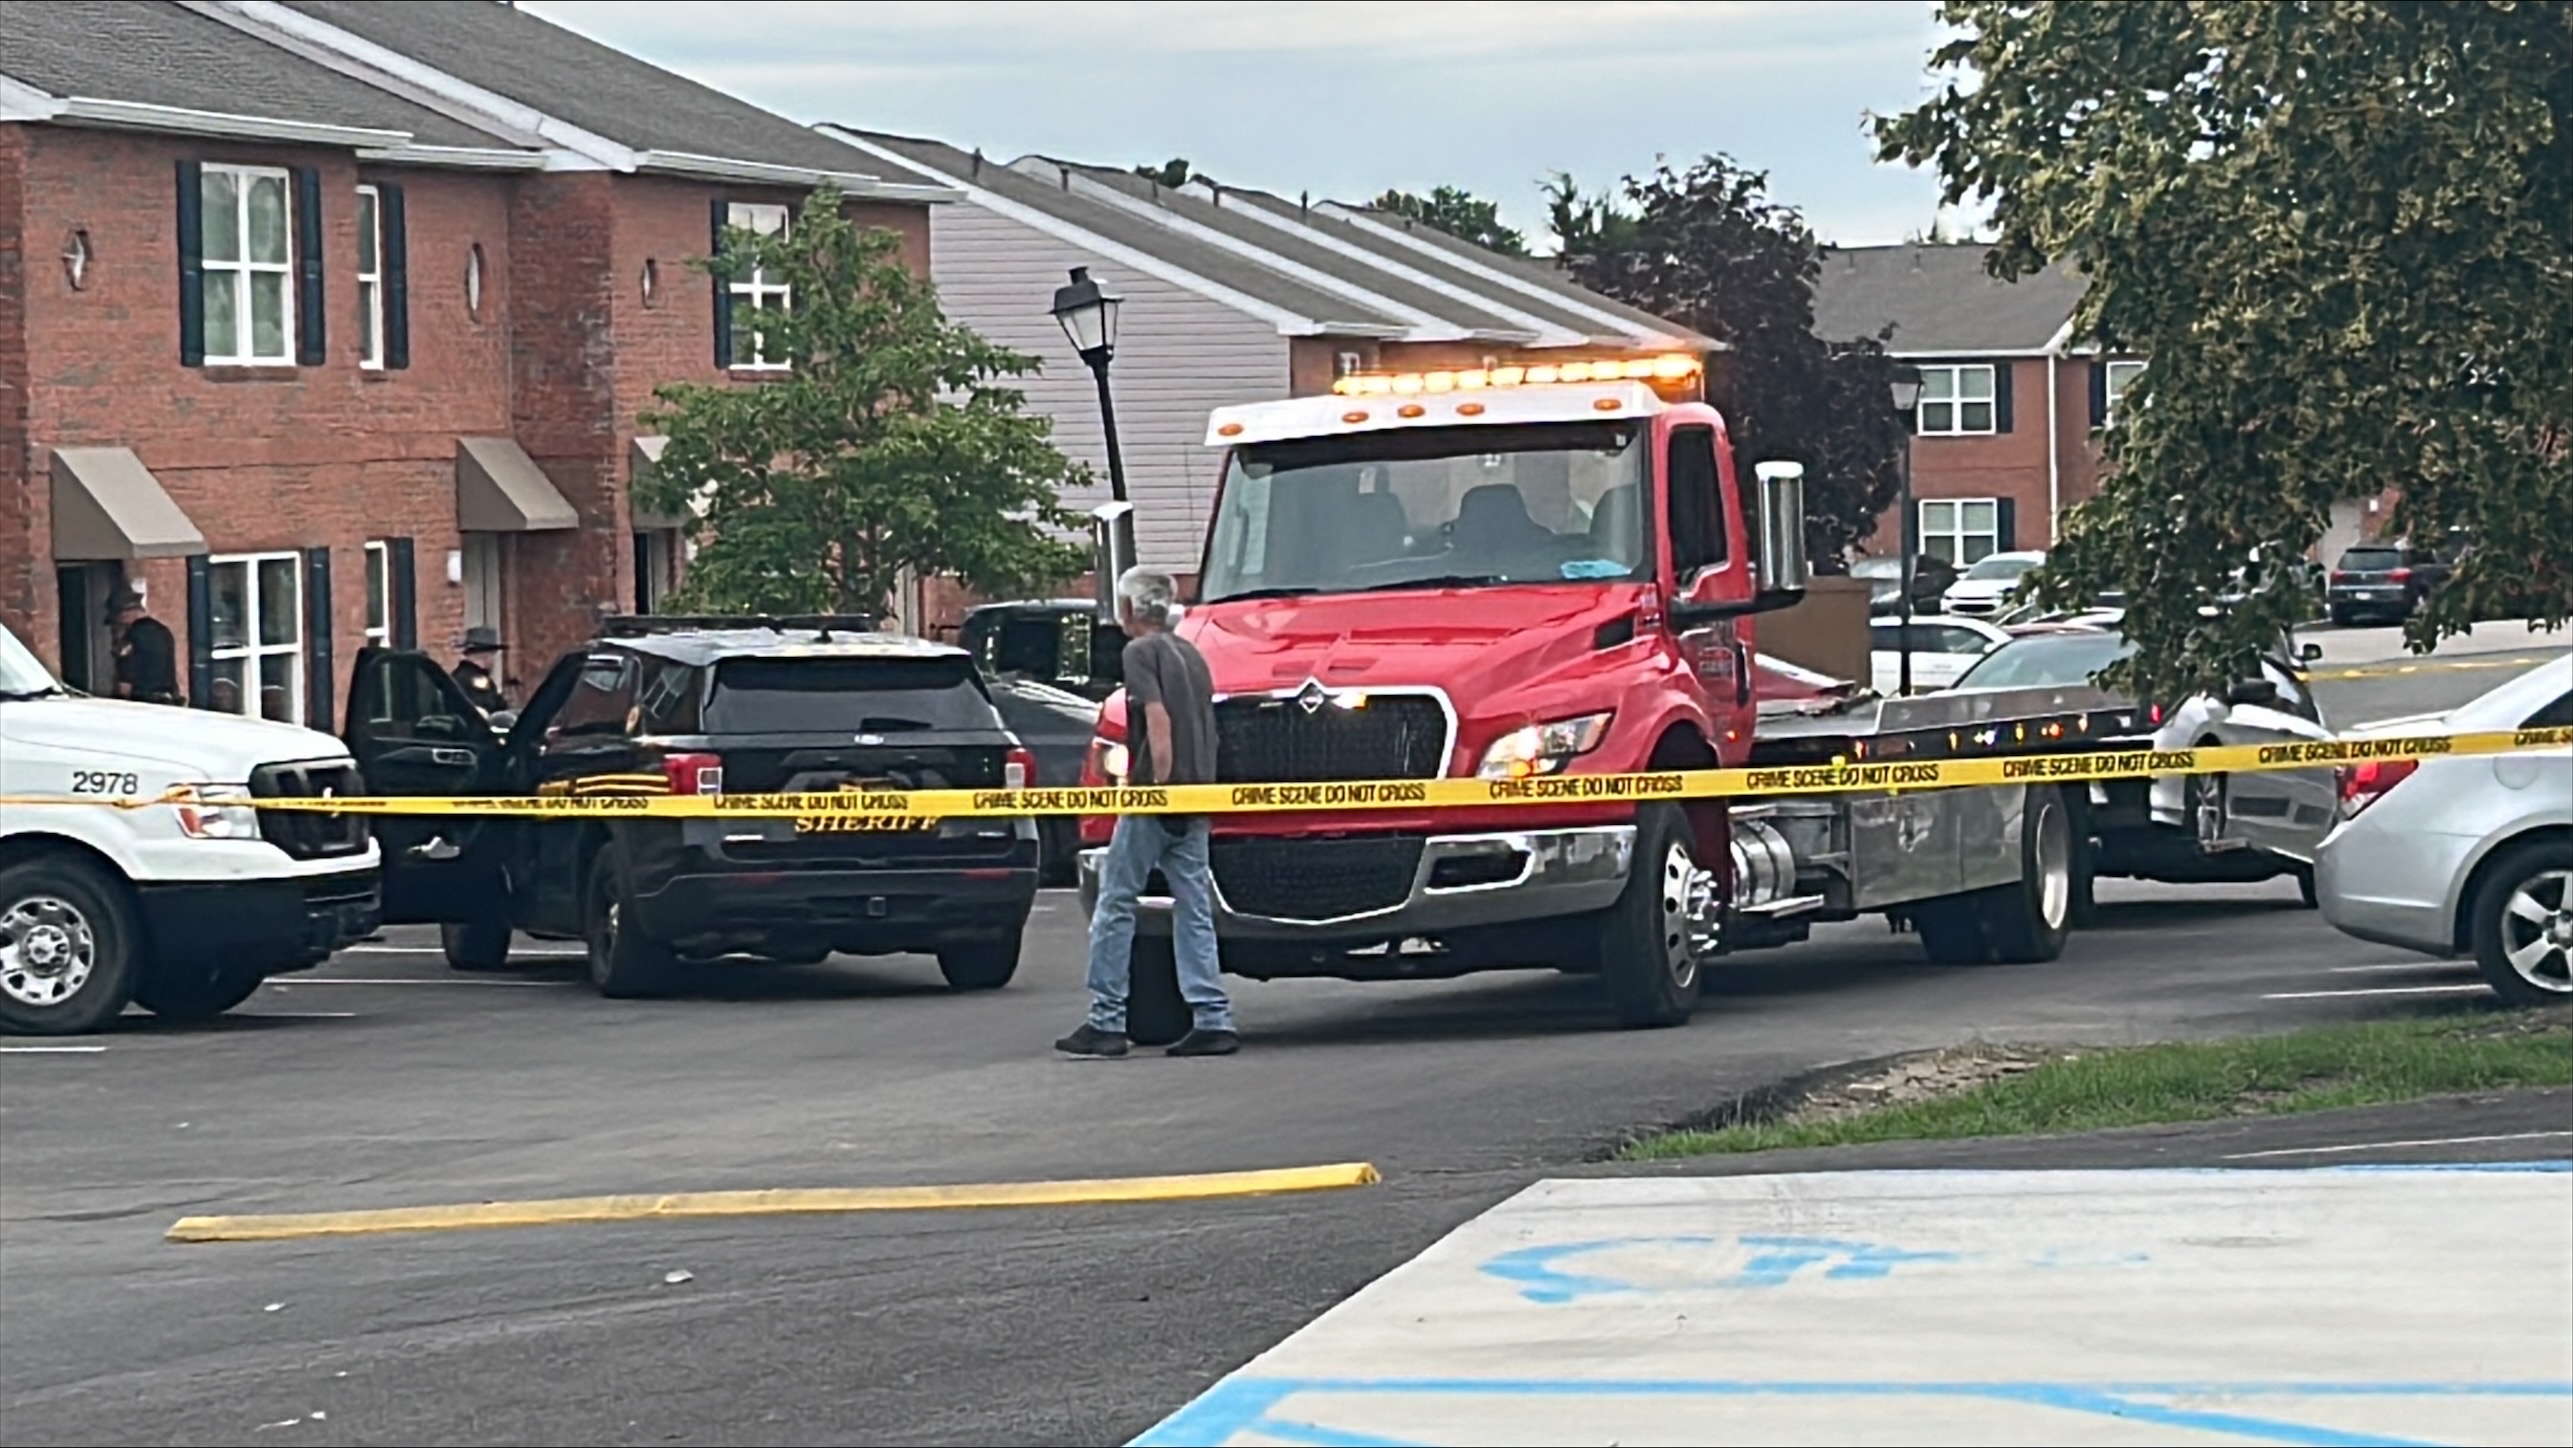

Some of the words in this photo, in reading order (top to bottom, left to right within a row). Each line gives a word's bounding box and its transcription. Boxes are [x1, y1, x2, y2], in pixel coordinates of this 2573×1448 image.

[2259, 744, 2302, 764] CRIME
[2350, 740, 2371, 758] DO
[2373, 739, 2400, 756] NOT
[2403, 736, 2450, 753] CROSS
[2003, 759, 2047, 778] CRIME
[2049, 757, 2093, 775] SCENE
[2095, 755, 2115, 772] DO
[2118, 753, 2146, 771] NOT
[2148, 751, 2194, 769] CROSS
[72, 771, 138, 794] 2978
[1489, 780, 1534, 799] CRIME
[1537, 778, 1580, 797] SCENE
[1583, 777, 1602, 796] DO
[1605, 776, 1633, 795] NOT
[1635, 775, 1683, 793] CROSS
[1747, 770, 1792, 789] CRIME
[1794, 768, 1837, 787] SCENE
[1839, 767, 1859, 786] DO
[1861, 765, 1889, 785] NOT
[1892, 764, 1939, 783] CROSS
[973, 792, 1017, 809] CRIME
[1021, 791, 1064, 809] SCENE
[1067, 790, 1087, 808] DO
[1090, 789, 1118, 808] NOT
[1120, 789, 1168, 807] CROSS
[1232, 787, 1276, 805] CRIME
[1280, 785, 1322, 804] SCENE
[1325, 785, 1345, 802] DO
[1349, 784, 1376, 802] NOT
[1379, 783, 1425, 801] CROSS
[794, 815, 938, 832] SHERIFF
